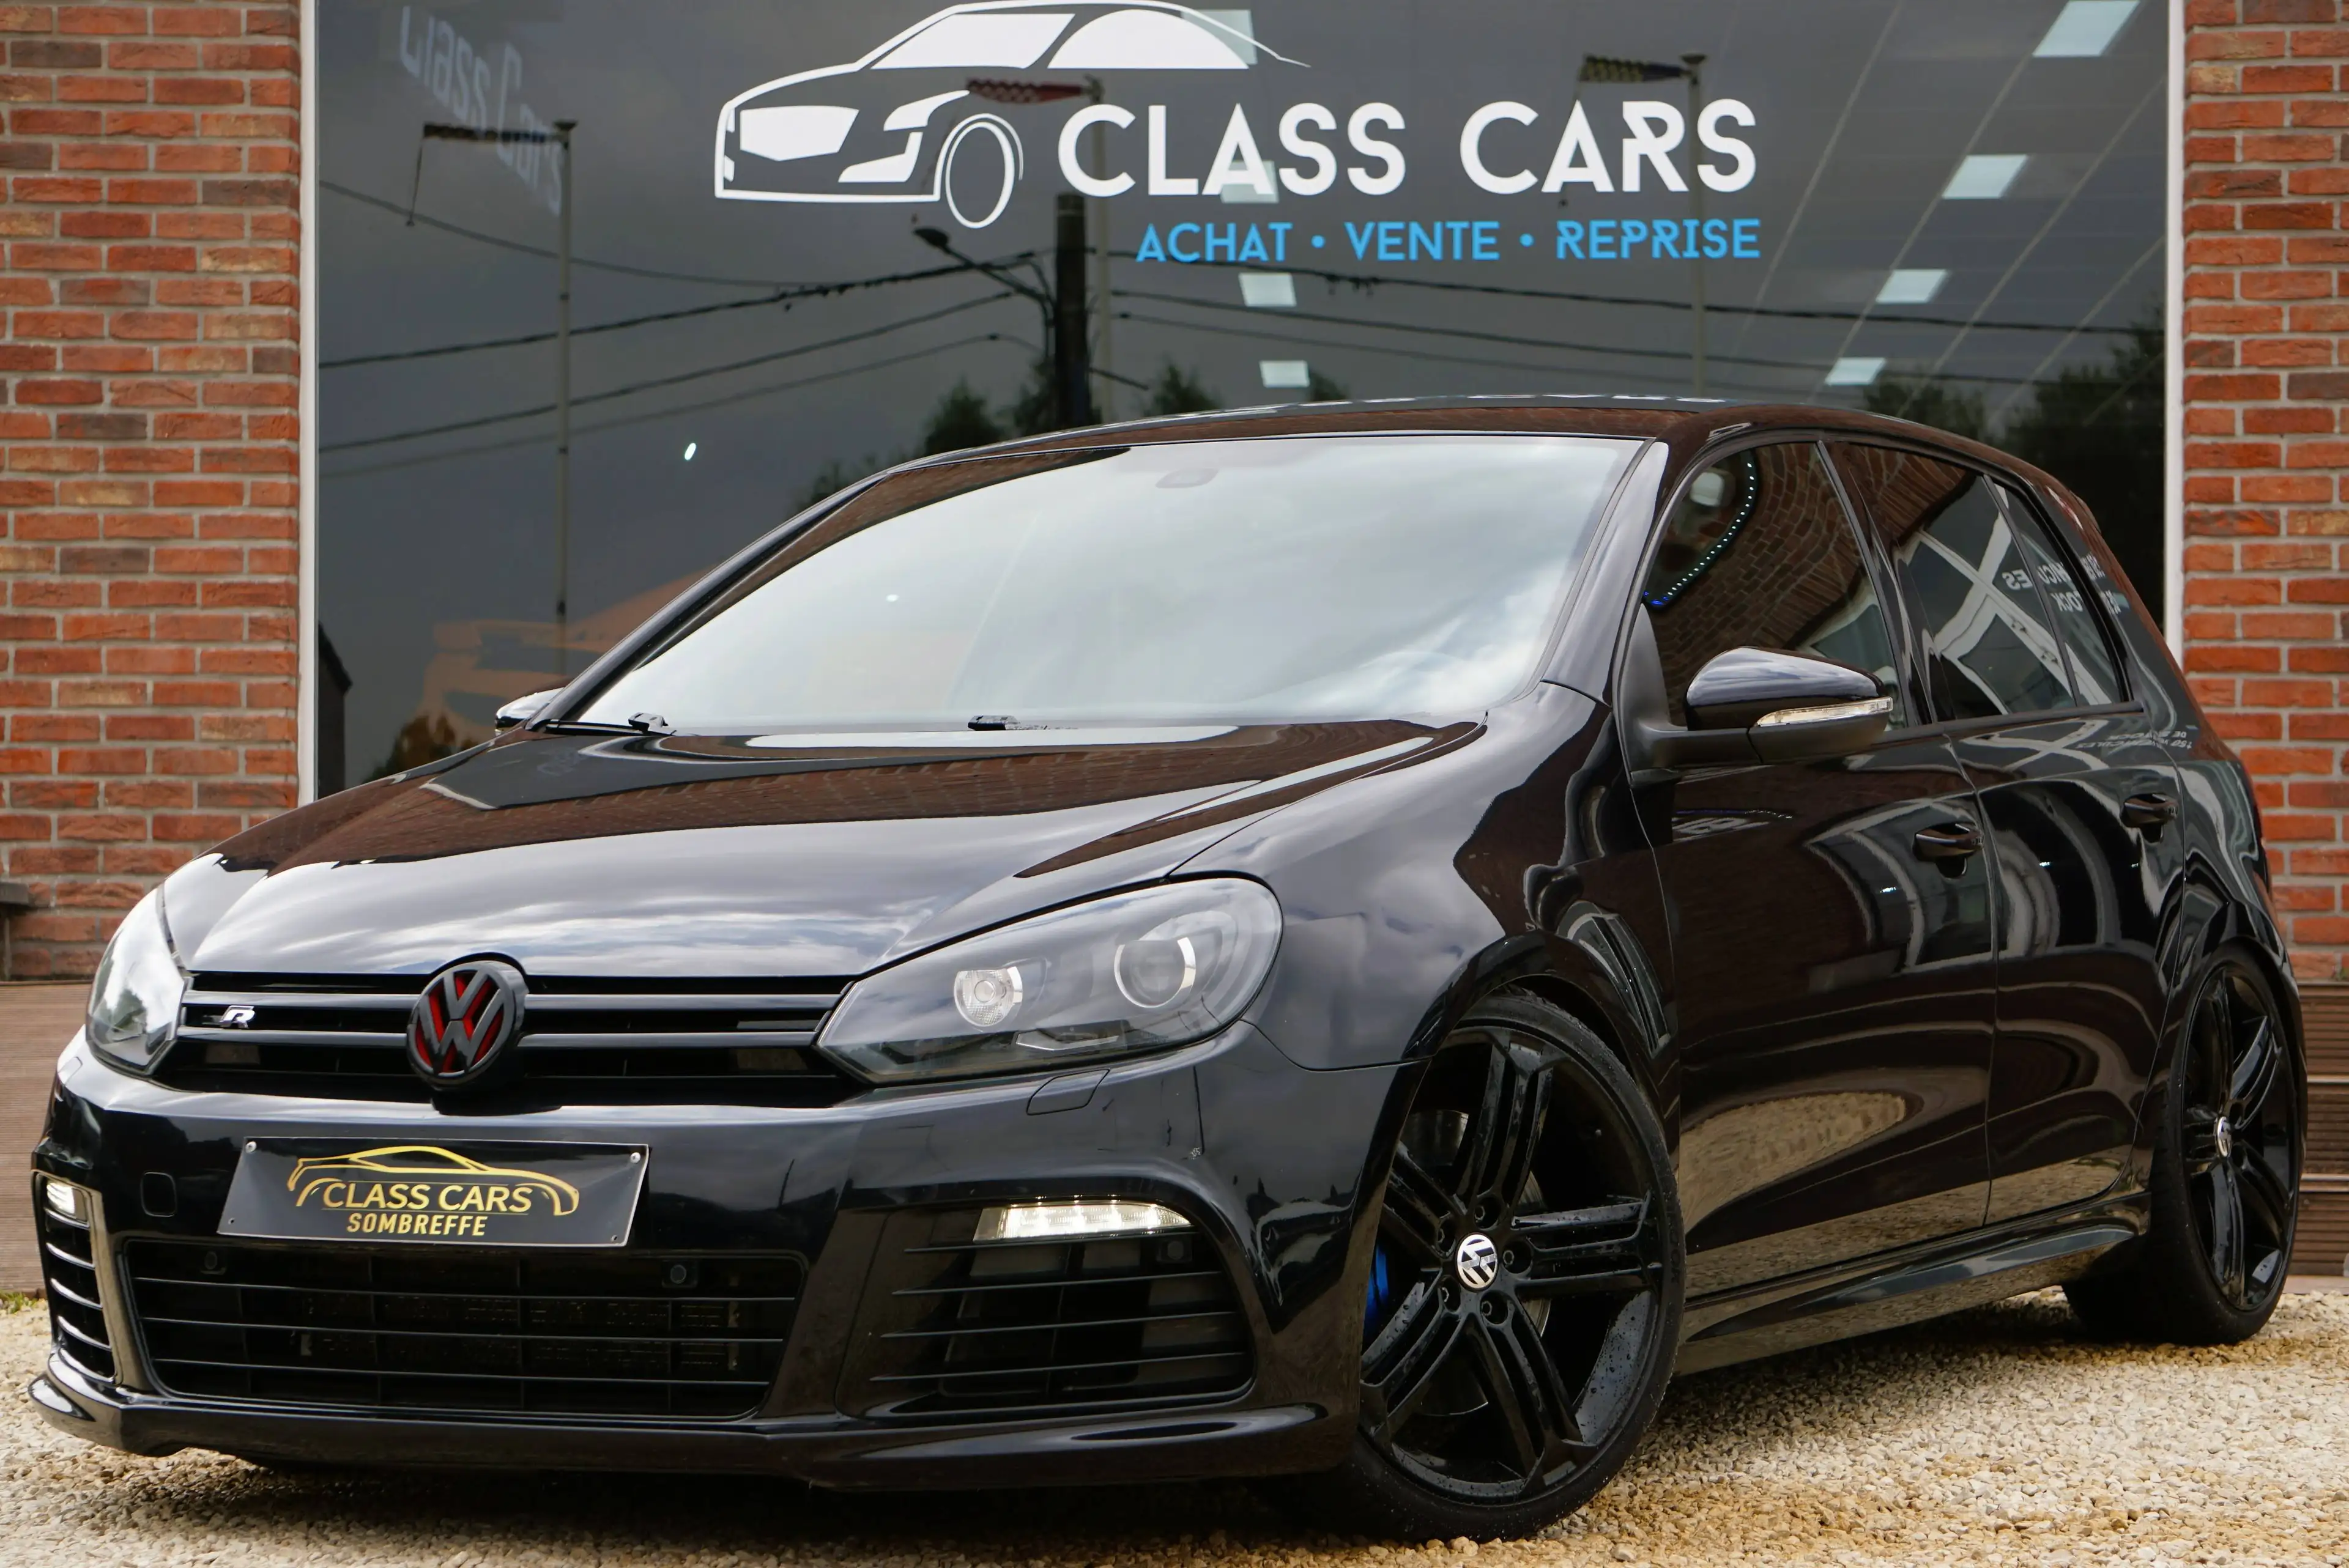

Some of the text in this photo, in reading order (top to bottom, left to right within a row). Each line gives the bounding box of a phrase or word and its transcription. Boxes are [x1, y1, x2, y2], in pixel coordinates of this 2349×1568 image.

[1058, 100, 1755, 197] CLASS CARS
[1135, 218, 1762, 263] ACHAT VENTE REPRISE
[219, 1005, 256, 1029] R
[323, 1182, 533, 1213] CLASS CARS
[346, 1212, 488, 1237] SOMBREFFE
